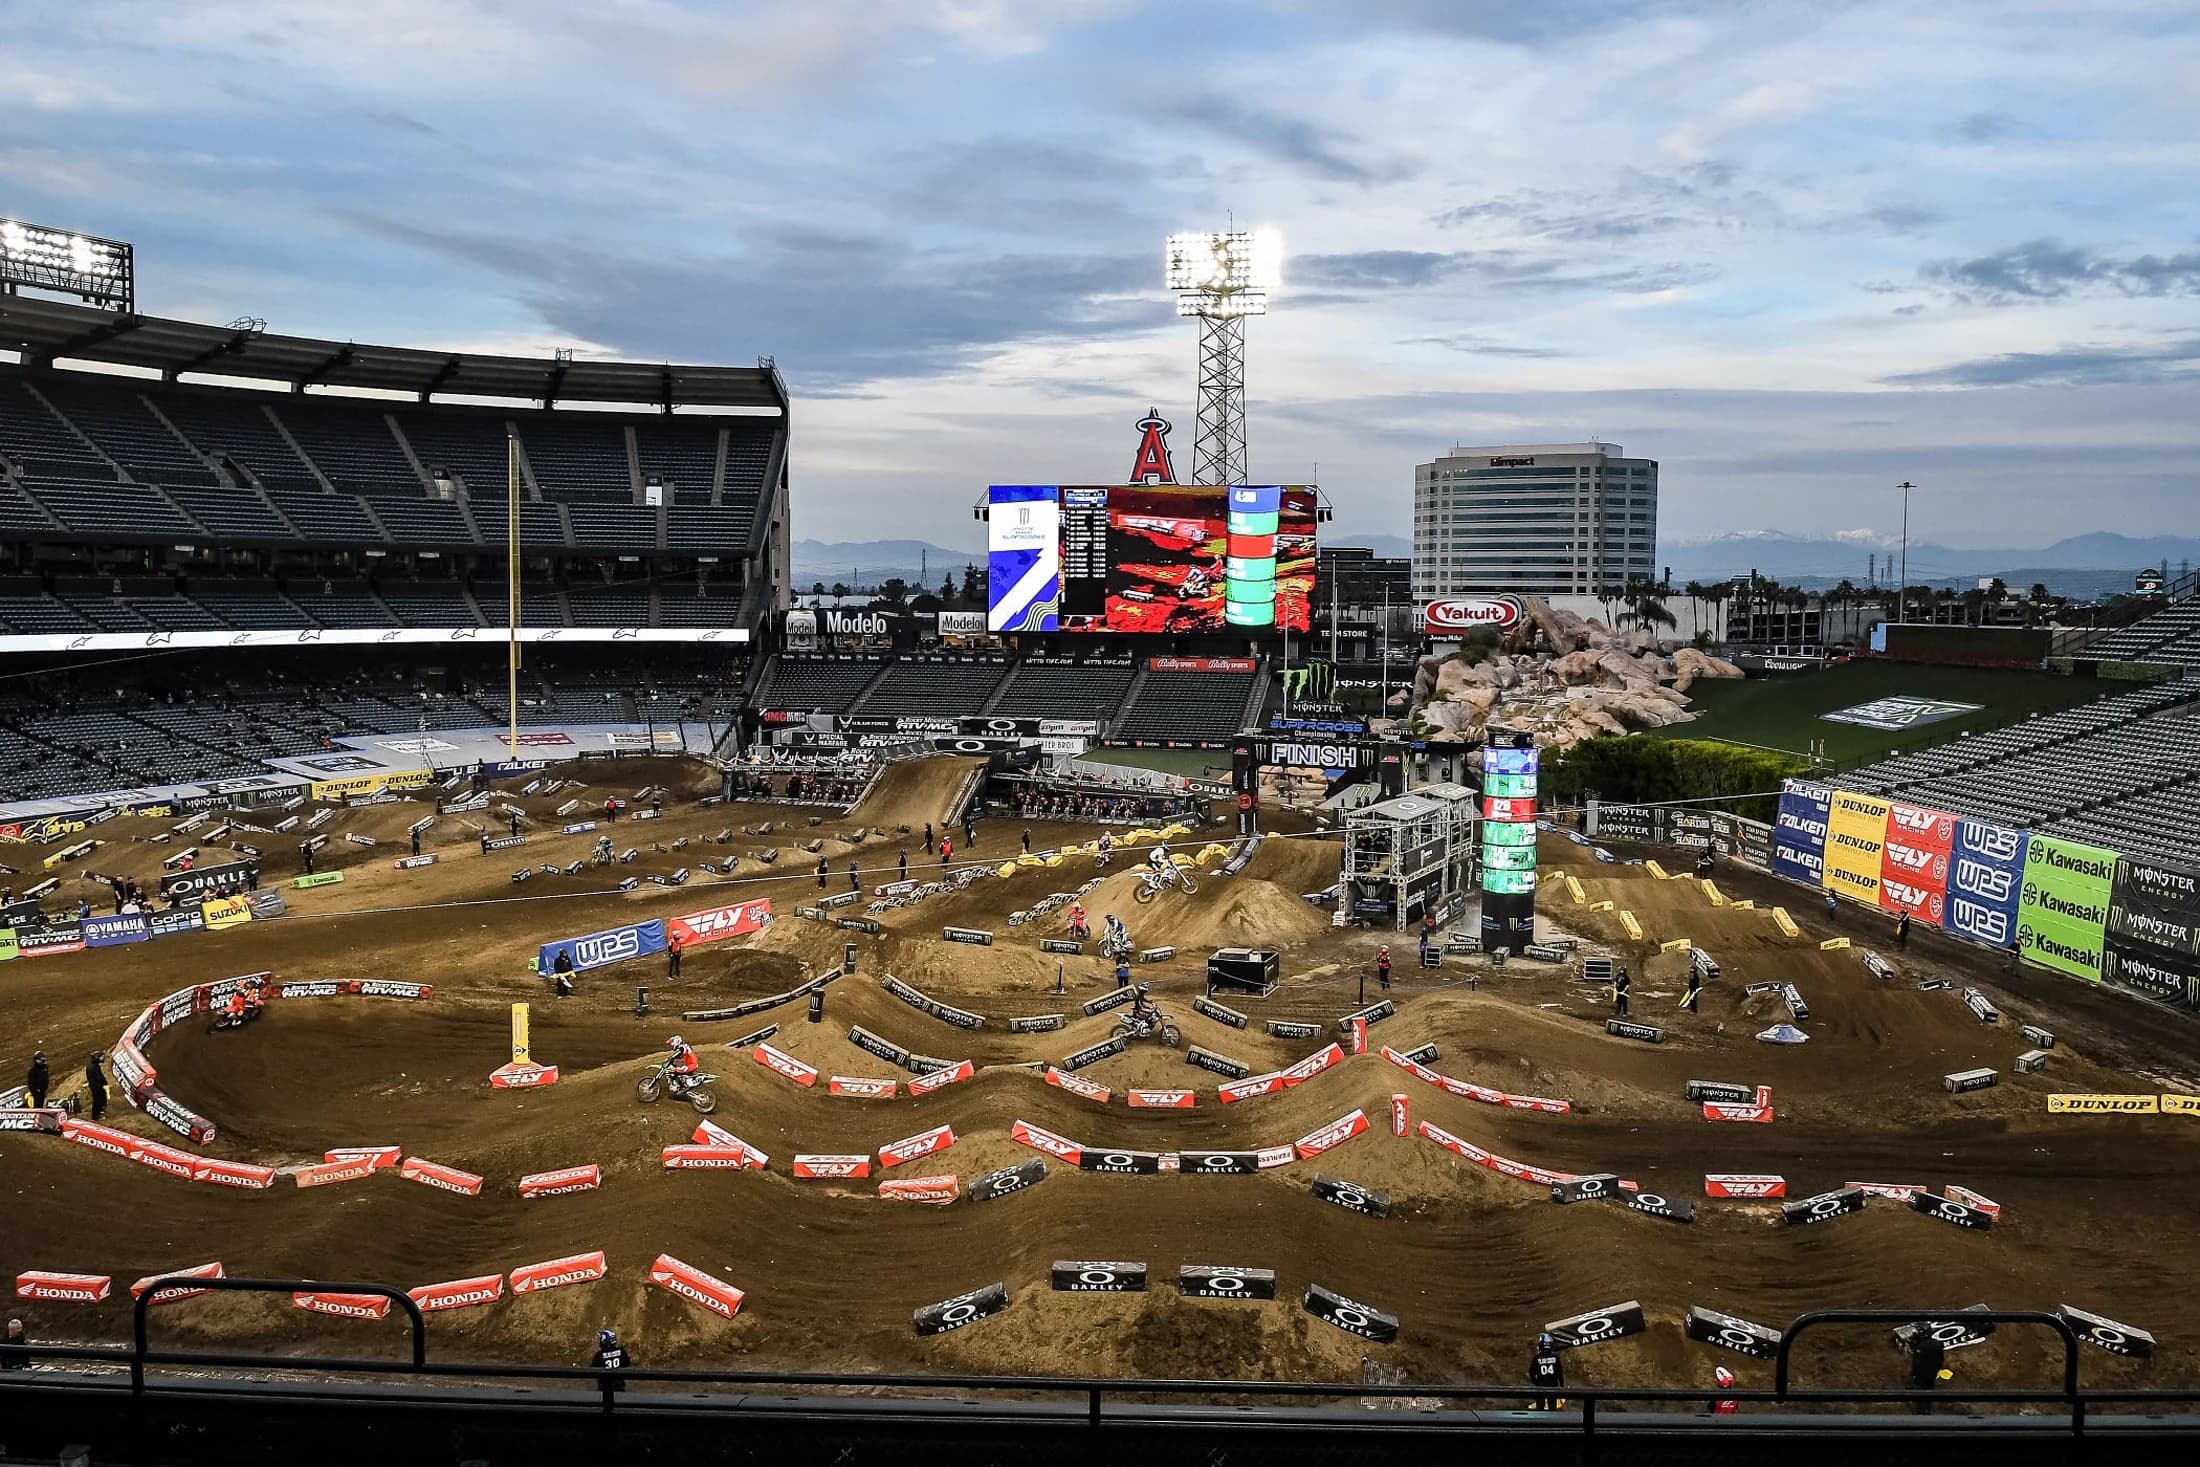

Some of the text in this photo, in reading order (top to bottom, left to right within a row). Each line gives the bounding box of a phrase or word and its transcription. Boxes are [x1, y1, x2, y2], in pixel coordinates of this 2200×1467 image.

[1499, 456, 1535, 468] impact
[945, 614, 982, 630] Modelo
[1441, 606, 1501, 620] Yakult
[826, 611, 887, 634] Modelo
[1157, 658, 1180, 670] Bally
[1208, 659, 1231, 670] Bally
[1292, 702, 1342, 713] MONSTER
[1270, 719, 1365, 732] SUPERCROSS
[1294, 730, 1337, 738] Championship
[1271, 742, 1358, 768] FINISH
[258, 787, 299, 799] MONSTER
[326, 780, 372, 792] DUNLOP
[1784, 780, 1831, 803] FALKEN
[185, 796, 229, 808] MONSTER
[1841, 799, 1887, 817] DUNLOP
[1599, 805, 1650, 818] MONSTER
[1891, 806, 1937, 829] FLY
[1599, 823, 1649, 836] MONSTER
[1779, 813, 1826, 837] FALKEN
[1897, 824, 1926, 836] RACING
[1836, 833, 1881, 853] DUNLOP
[1963, 821, 2019, 861] WPS
[1776, 845, 1823, 870] FALKEN
[1886, 841, 1933, 867] FLY
[1892, 861, 1921, 873] RACING
[2046, 847, 2113, 881] Kawasaki
[1833, 868, 1878, 889] DUNLOP
[1956, 858, 2013, 902] WPS
[2133, 865, 2196, 893] MONSTER
[1881, 878, 1929, 906] FLY
[2141, 884, 2185, 901] ENERGY
[209, 904, 249, 921] SUZUKI
[1890, 898, 1918, 911] RACING
[2039, 890, 2105, 925] Kawasaki
[99, 918, 145, 932] YAMAHA
[151, 911, 201, 926] GoPro
[683, 907, 744, 934] FLY
[1953, 897, 2007, 944] WPS
[2127, 912, 2188, 942] MONSTER
[700, 926, 736, 939] RACING
[2133, 931, 2176, 949] ENERGY
[575, 928, 640, 968] WPS
[2036, 932, 2101, 970] Kawasaki
[2121, 956, 2182, 989] MONSTER
[891, 981, 924, 1005] MONSTER
[2130, 978, 2172, 995] ENERGY
[1093, 991, 1127, 1012] MONSTER
[941, 1006, 974, 1024] MONSTER
[1020, 1018, 1053, 1029] MONSTER
[1203, 1004, 1237, 1026] MONSTER
[1278, 1024, 1311, 1036] MONSTER
[1619, 1025, 1655, 1036] MONSTER
[861, 1034, 897, 1058] MONSTER
[1075, 1044, 1113, 1066] MONSTER
[768, 1052, 806, 1077] FLY
[1200, 1055, 1237, 1076] MONSTER
[1290, 1053, 1331, 1080] FLY
[924, 1066, 960, 1088] FLY
[840, 1082, 883, 1094] FLY
[1229, 1079, 1272, 1099] FLY
[1702, 1089, 1739, 1098] MONSTER
[1140, 1092, 1184, 1104] FLY
[2068, 1100, 2151, 1110] DUNLOP
[2181, 1101, 2200, 1110] DU
[1714, 1106, 1768, 1118] FLY
[1026, 1130, 1074, 1153] FLY
[1307, 1120, 1354, 1147] FLY
[75, 1133, 127, 1157] HONDA
[889, 1135, 940, 1157] FLY
[143, 1154, 192, 1177] HONDA
[681, 1158, 740, 1168] HONDA
[803, 1163, 859, 1177] FLY
[1096, 1164, 1140, 1174] OAKLEY
[1197, 1165, 1241, 1174] OAKLEY
[210, 1173, 264, 1188] HONDA
[313, 1166, 365, 1184] HONDA
[419, 1174, 470, 1195] HONDA
[989, 1180, 1030, 1199] OAKLEY
[1722, 1182, 1774, 1194] FLY
[1576, 1189, 1607, 1200] OAKLEY
[1326, 1195, 1370, 1215] OAKLEY
[1628, 1201, 1673, 1217] OAKLEY
[1806, 1206, 1849, 1224] OAKLEY
[1930, 1208, 1973, 1228] OAKLEY
[533, 1268, 600, 1289] HONDA
[1071, 1283, 1125, 1291] OAKLEY
[35, 1287, 96, 1300] HONDA
[429, 1289, 495, 1308] HONDA
[668, 1279, 732, 1315] HONDA
[1199, 1289, 1253, 1299] OAKLEY
[312, 1301, 378, 1318] HONDA
[938, 1311, 988, 1334] OAKLEY
[1323, 1314, 1374, 1338] OAKLEY
[1572, 1326, 1625, 1347] OAKLEY
[1707, 1335, 1759, 1356] OAKLEY
[2078, 1333, 2130, 1354] OAKLEY
[604, 1358, 620, 1369] 30
[1540, 1364, 1554, 1376] 04
